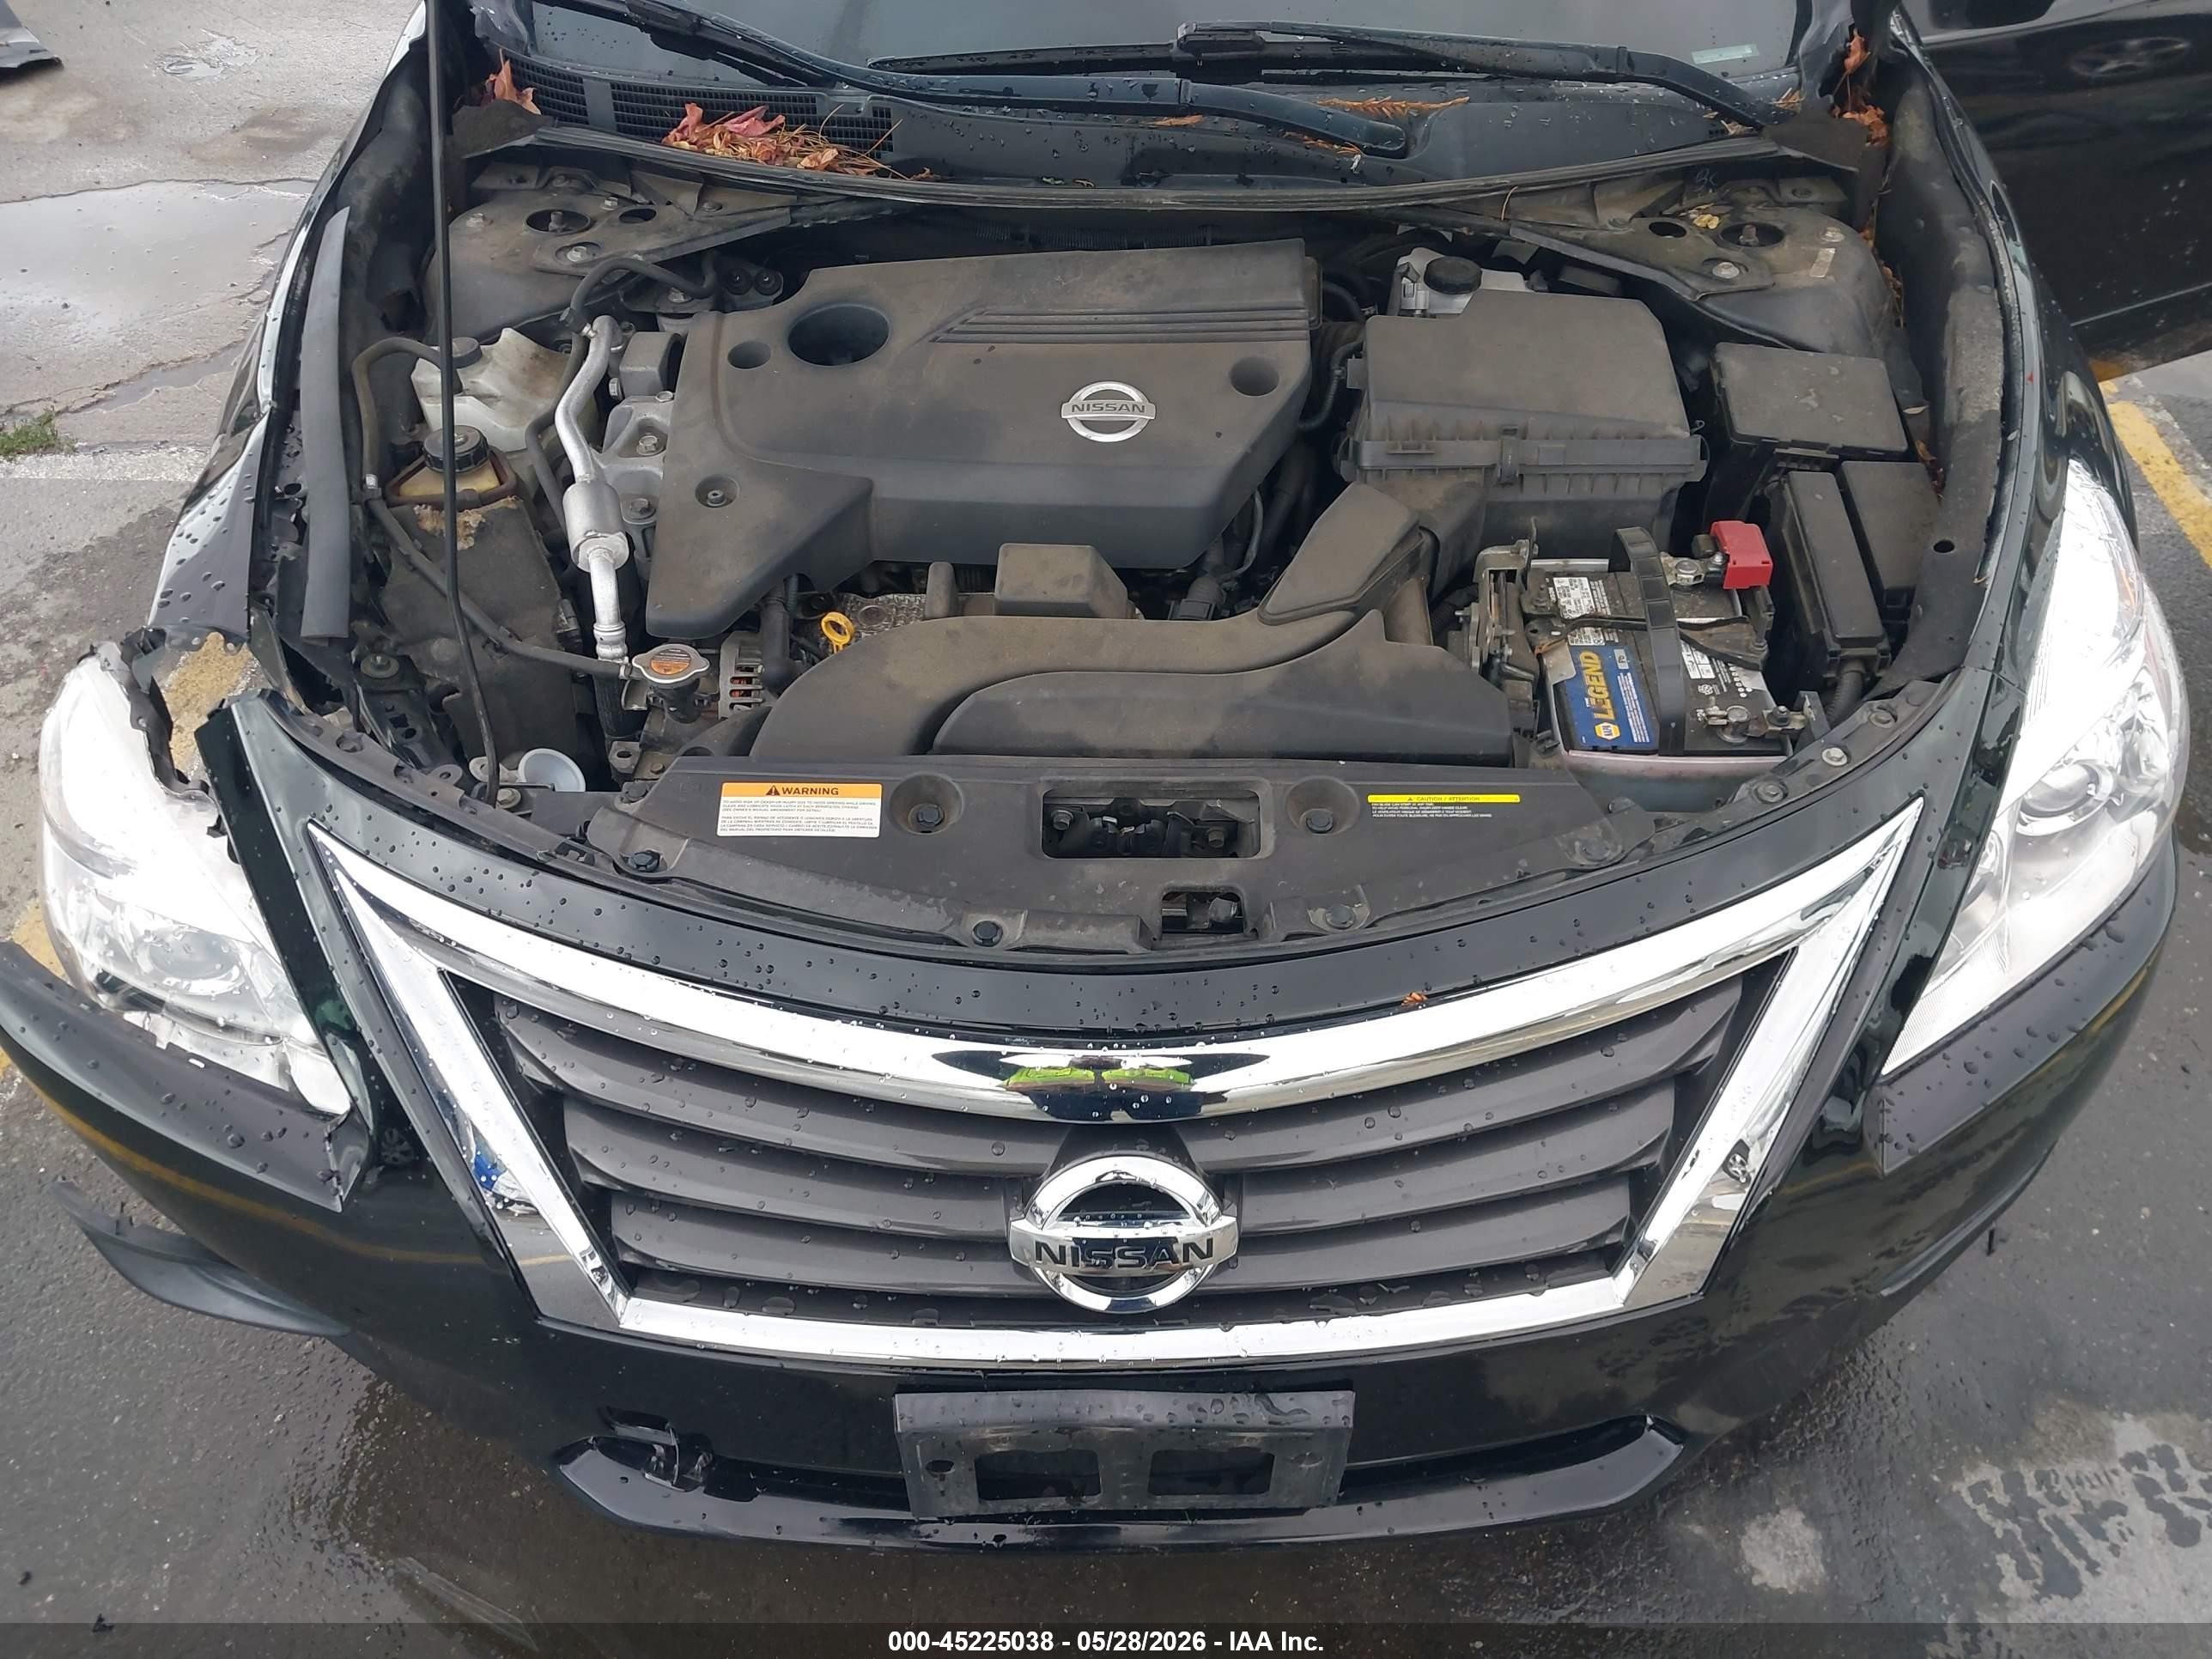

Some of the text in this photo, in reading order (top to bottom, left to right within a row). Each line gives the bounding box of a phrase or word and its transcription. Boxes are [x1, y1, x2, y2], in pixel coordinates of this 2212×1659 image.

[1072, 403, 1146, 413] NISSAN
[1579, 650, 1615, 720] LEGEND
[781, 787, 839, 796] WARNING
[1034, 1237, 1214, 1268] NISSAN
